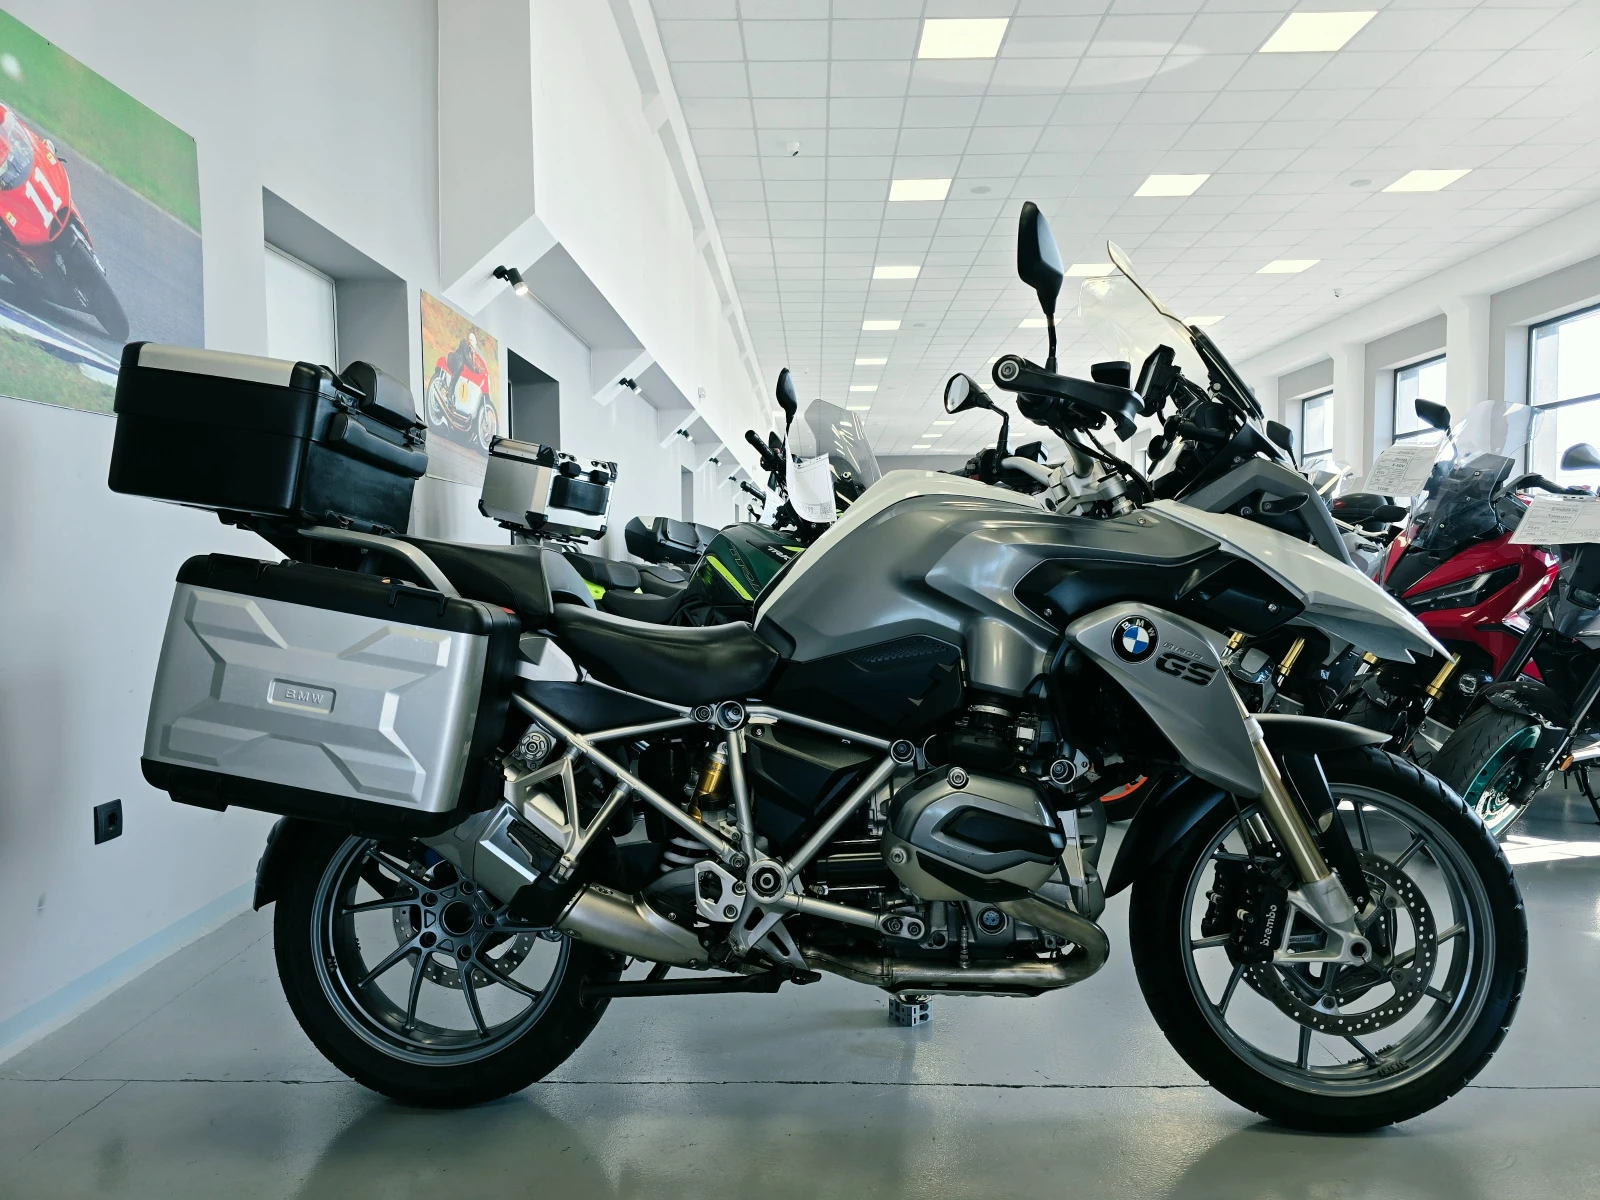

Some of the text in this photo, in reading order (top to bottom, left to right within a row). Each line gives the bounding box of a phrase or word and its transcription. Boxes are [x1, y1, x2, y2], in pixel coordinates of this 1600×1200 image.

[25, 166, 63, 230] 11
[1121, 618, 1156, 637] BMW
[1155, 652, 1218, 687] GS
[284, 688, 324, 705] BMW
[1259, 904, 1278, 947] brembo
